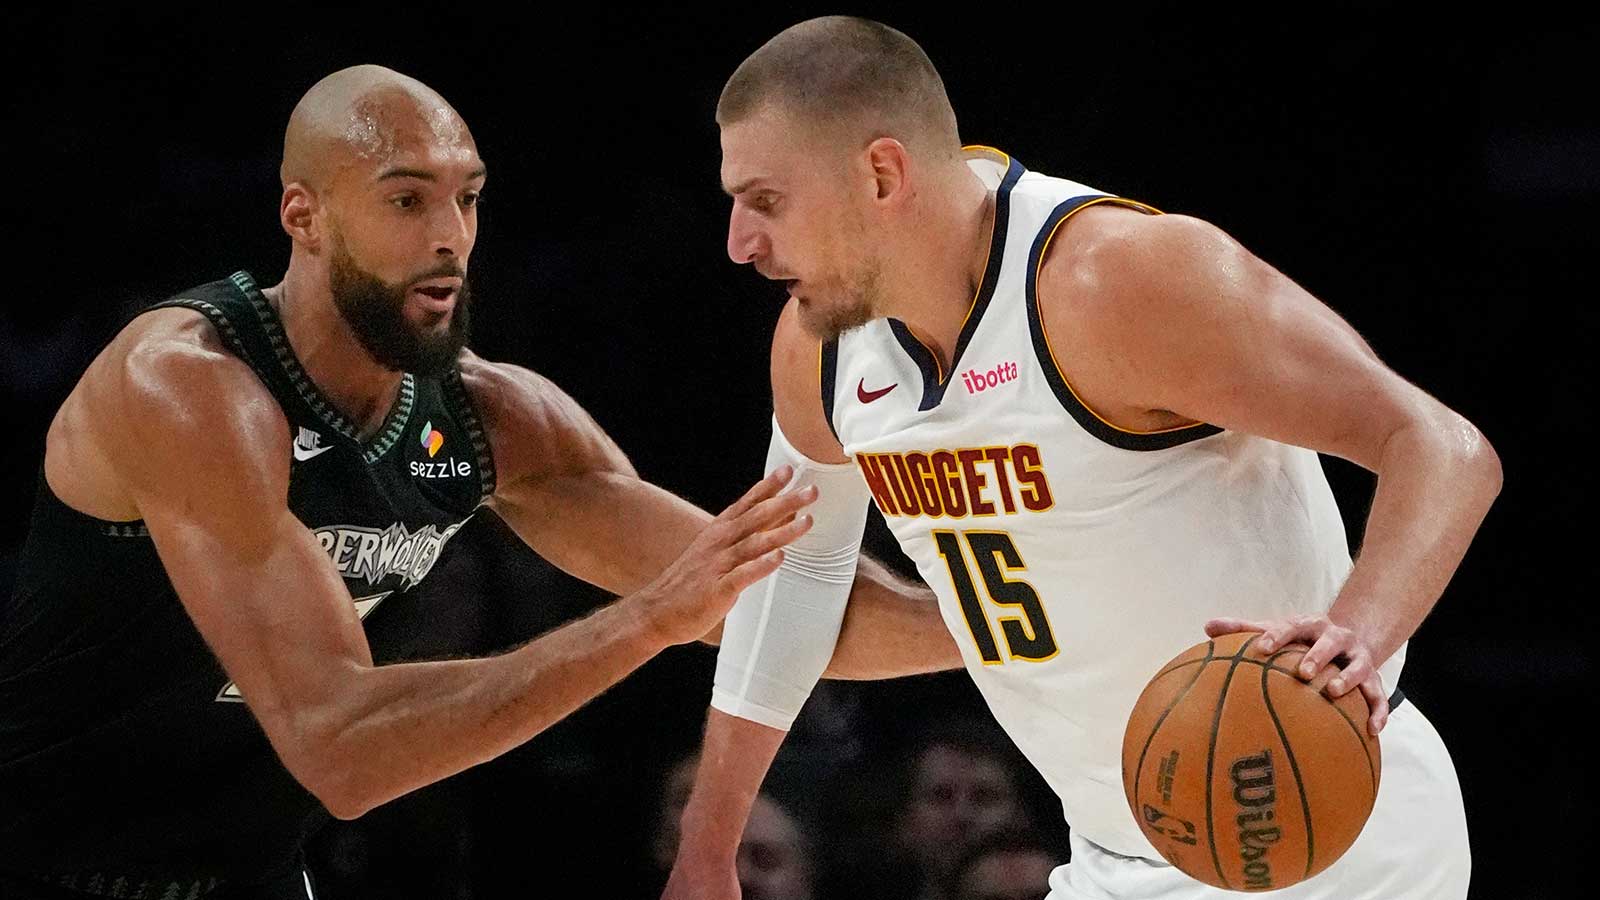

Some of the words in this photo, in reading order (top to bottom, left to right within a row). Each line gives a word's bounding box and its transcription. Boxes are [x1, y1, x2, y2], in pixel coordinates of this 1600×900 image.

[961, 361, 1018, 394] ibotta
[298, 425, 321, 449] NIKE
[409, 457, 472, 478] sezzle
[855, 442, 1055, 518] NUGGETS
[931, 529, 1060, 665] 15
[1229, 748, 1281, 888] Wilson
